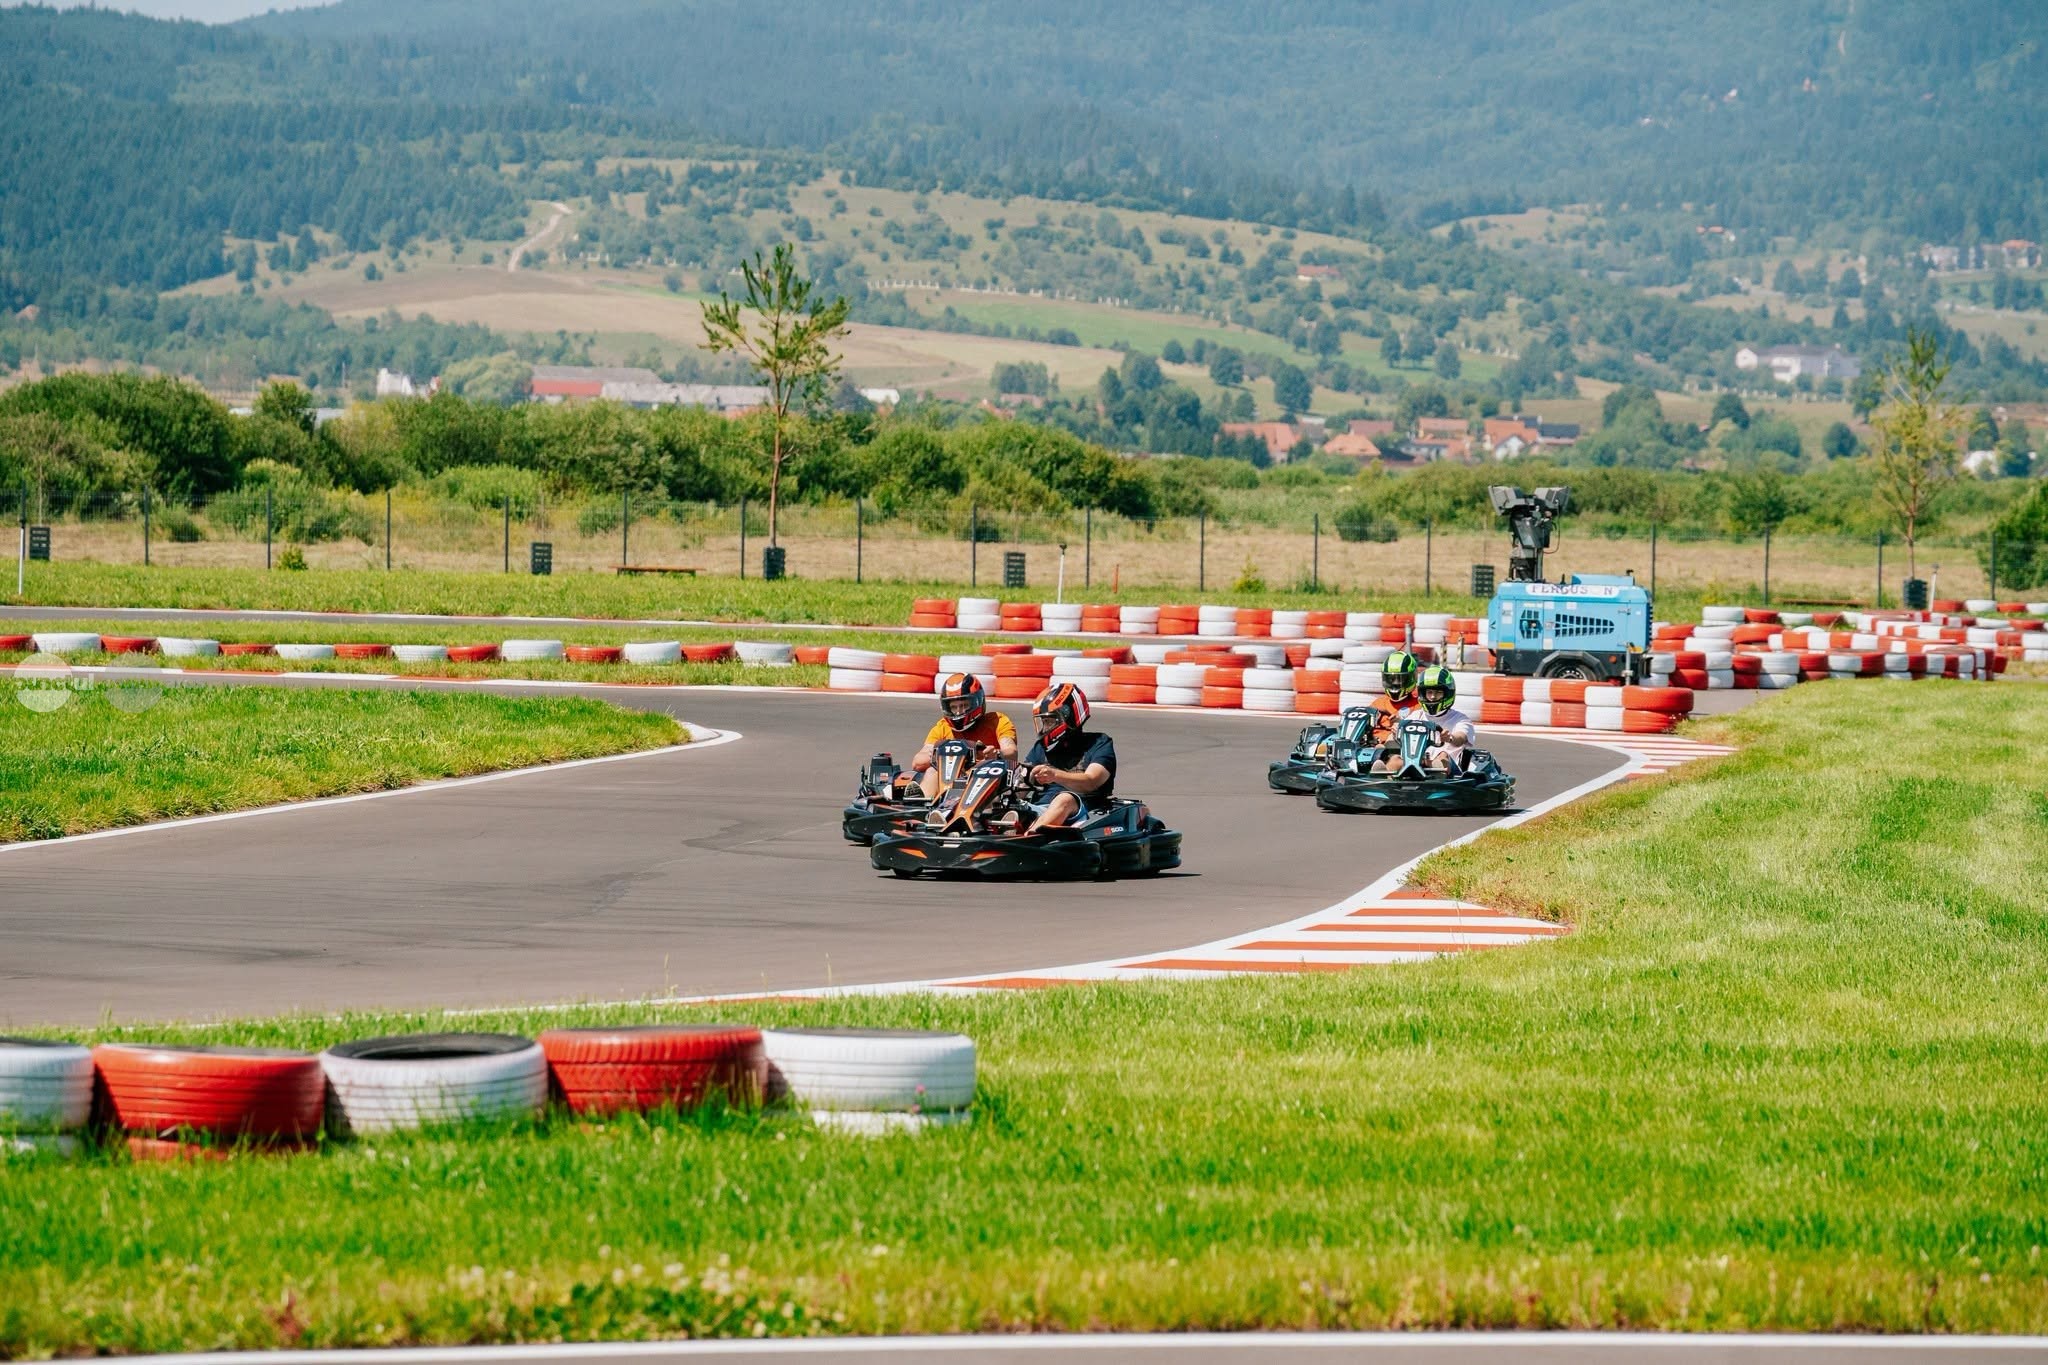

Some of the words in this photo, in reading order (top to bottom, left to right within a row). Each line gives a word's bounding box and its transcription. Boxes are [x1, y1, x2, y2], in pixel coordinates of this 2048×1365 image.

[1531, 584, 1613, 595] FERGUSN
[944, 745, 963, 753] 19
[976, 766, 1004, 776] 20
